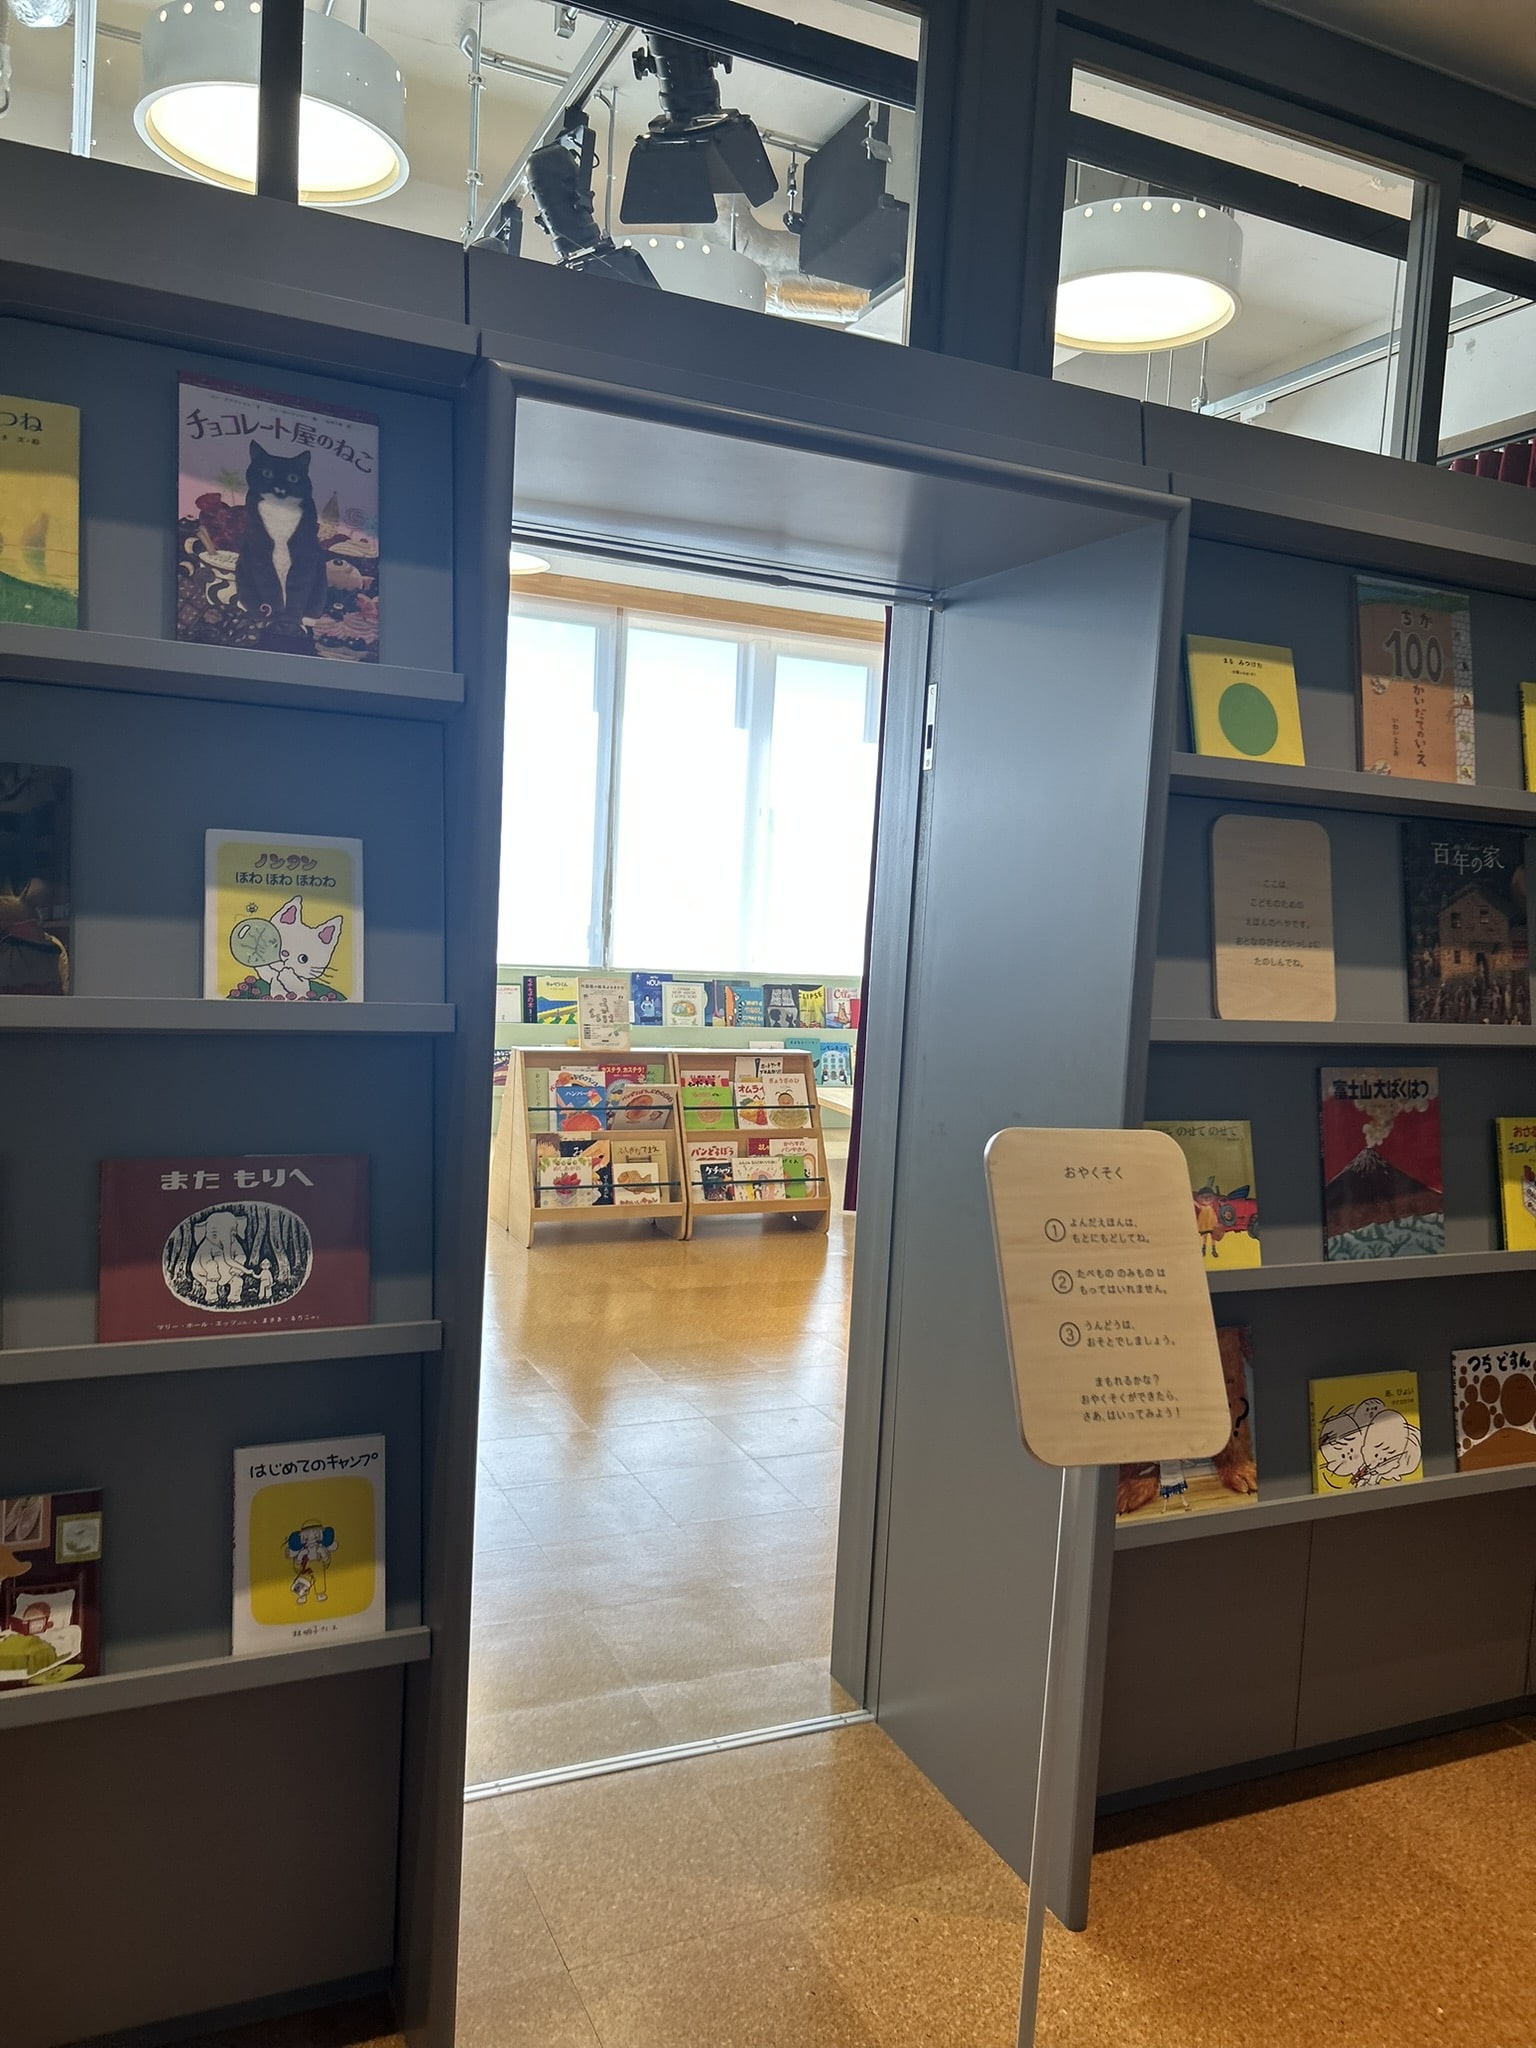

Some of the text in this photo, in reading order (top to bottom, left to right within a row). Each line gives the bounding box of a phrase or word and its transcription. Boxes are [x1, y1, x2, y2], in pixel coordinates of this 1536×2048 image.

[186, 408, 375, 474] チョコレート屋のねこ
[1385, 630, 1443, 683] 100
[1412, 684, 1427, 768] かいだてのいえ
[254, 853, 318, 871] ノンタン
[1431, 842, 1505, 875] 百年の家
[235, 871, 337, 888] ほわ ほわ ほわわ
[1332, 1078, 1430, 1100] 富士山大ばくはつ
[691, 1146, 735, 1157] パンどろぼう
[160, 1168, 315, 1191] また もりへ
[1064, 1166, 1124, 1180] おやくそく
[1069, 1218, 1138, 1228] よんだえほんは、
[1072, 1233, 1150, 1244] もとにもどしてね。
[1080, 1284, 1168, 1295] もってはいれません。
[1084, 1319, 1136, 1331] うんどうは、
[1087, 1334, 1176, 1348] おそとでしましょう。
[1468, 1350, 1532, 1374] つち どすん
[1095, 1373, 1161, 1387] まもれるかな？
[1081, 1392, 1179, 1405] おやくそくができたら、
[1083, 1407, 1181, 1422] さあ、はいってみよう！
[250, 1452, 379, 1479] はじめてのキャンプ
